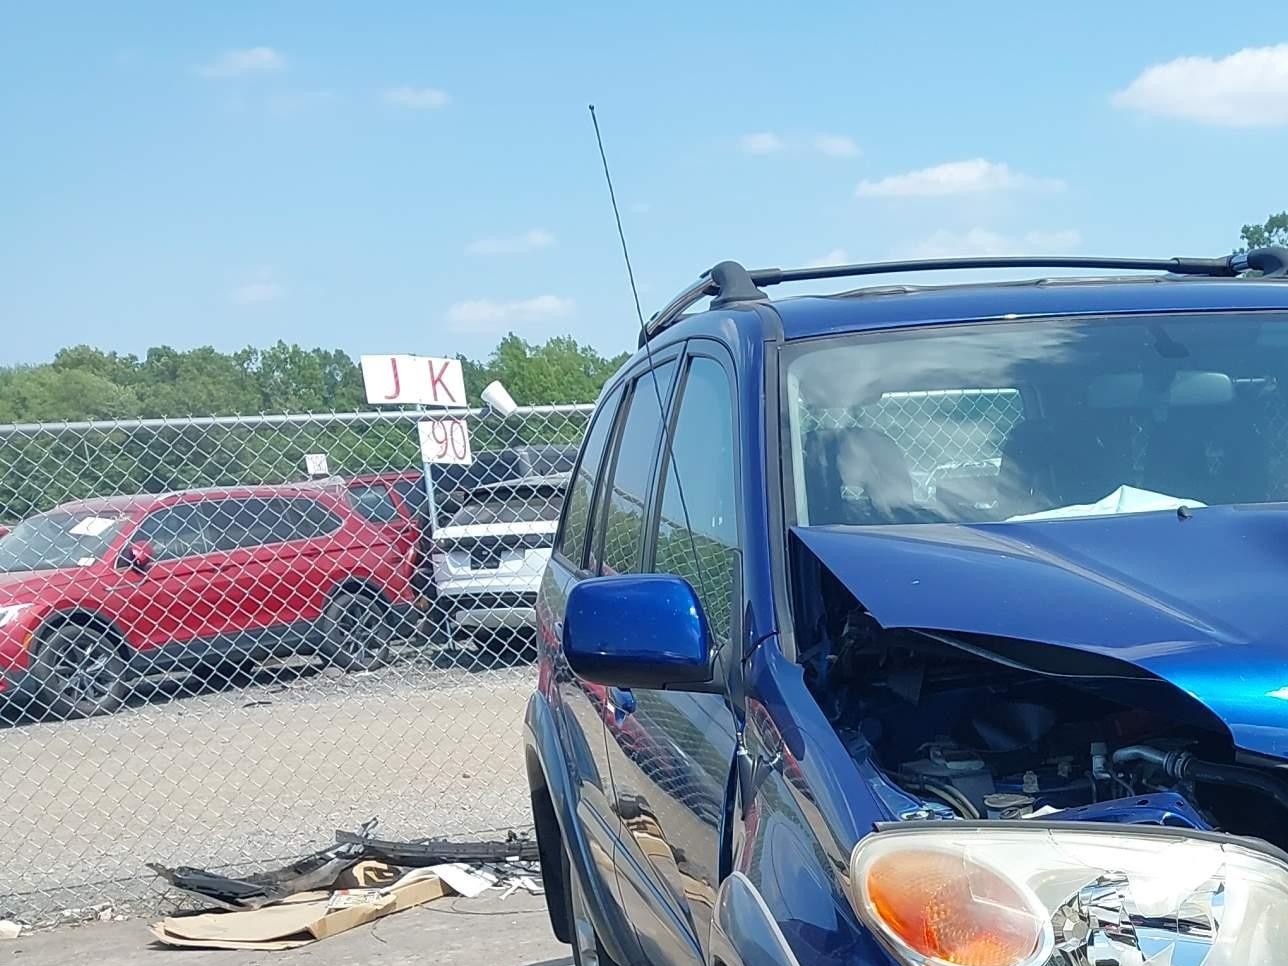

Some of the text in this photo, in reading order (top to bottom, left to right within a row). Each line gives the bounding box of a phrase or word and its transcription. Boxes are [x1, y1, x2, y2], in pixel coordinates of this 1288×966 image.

[384, 357, 456, 403] J K
[432, 420, 467, 460] 90
